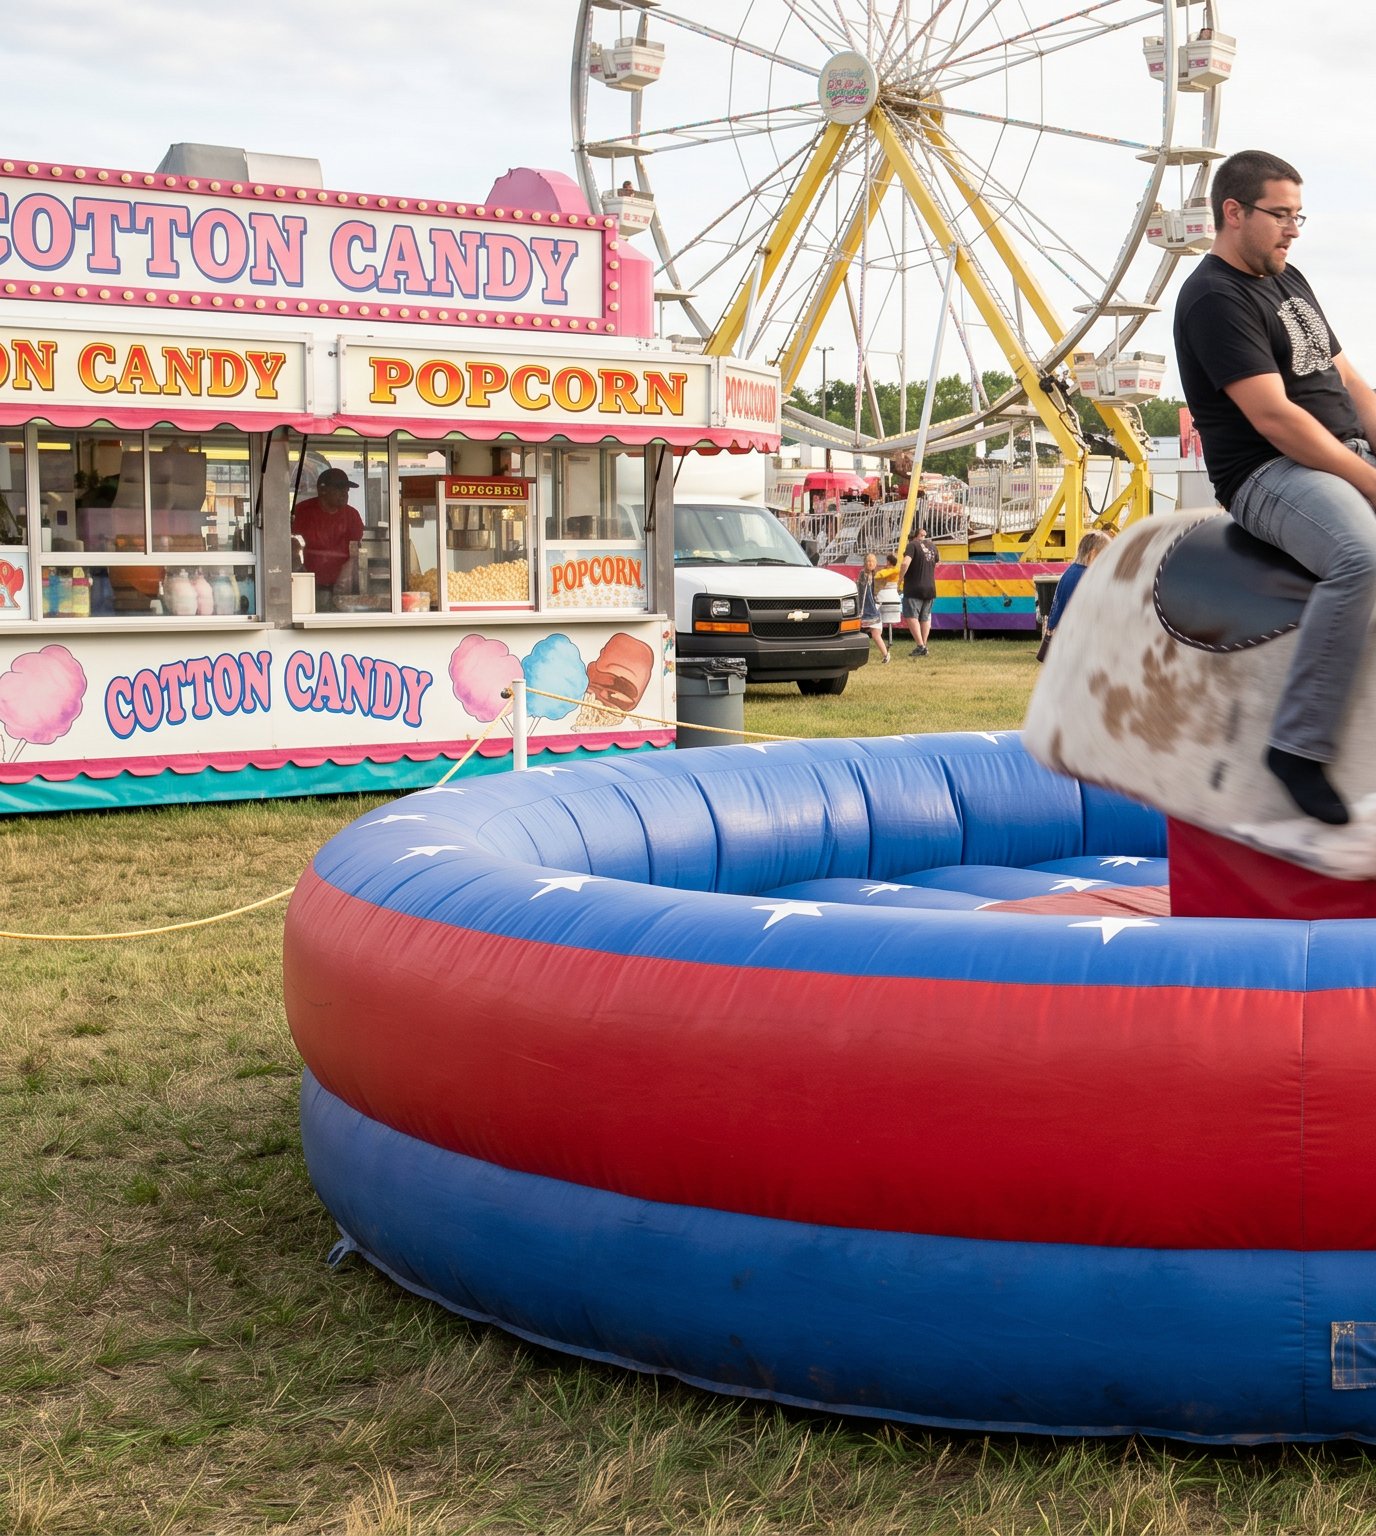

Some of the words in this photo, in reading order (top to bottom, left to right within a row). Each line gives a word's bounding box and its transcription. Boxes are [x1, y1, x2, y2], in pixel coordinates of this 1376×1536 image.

[0, 191, 307, 288] OTTON
[330, 220, 578, 306] CANDY
[77, 342, 286, 400] CANDY
[369, 356, 687, 416] POPCORN
[550, 555, 642, 597] POPCORN
[104, 650, 272, 740] COTTON
[284, 650, 434, 728] CANDY
